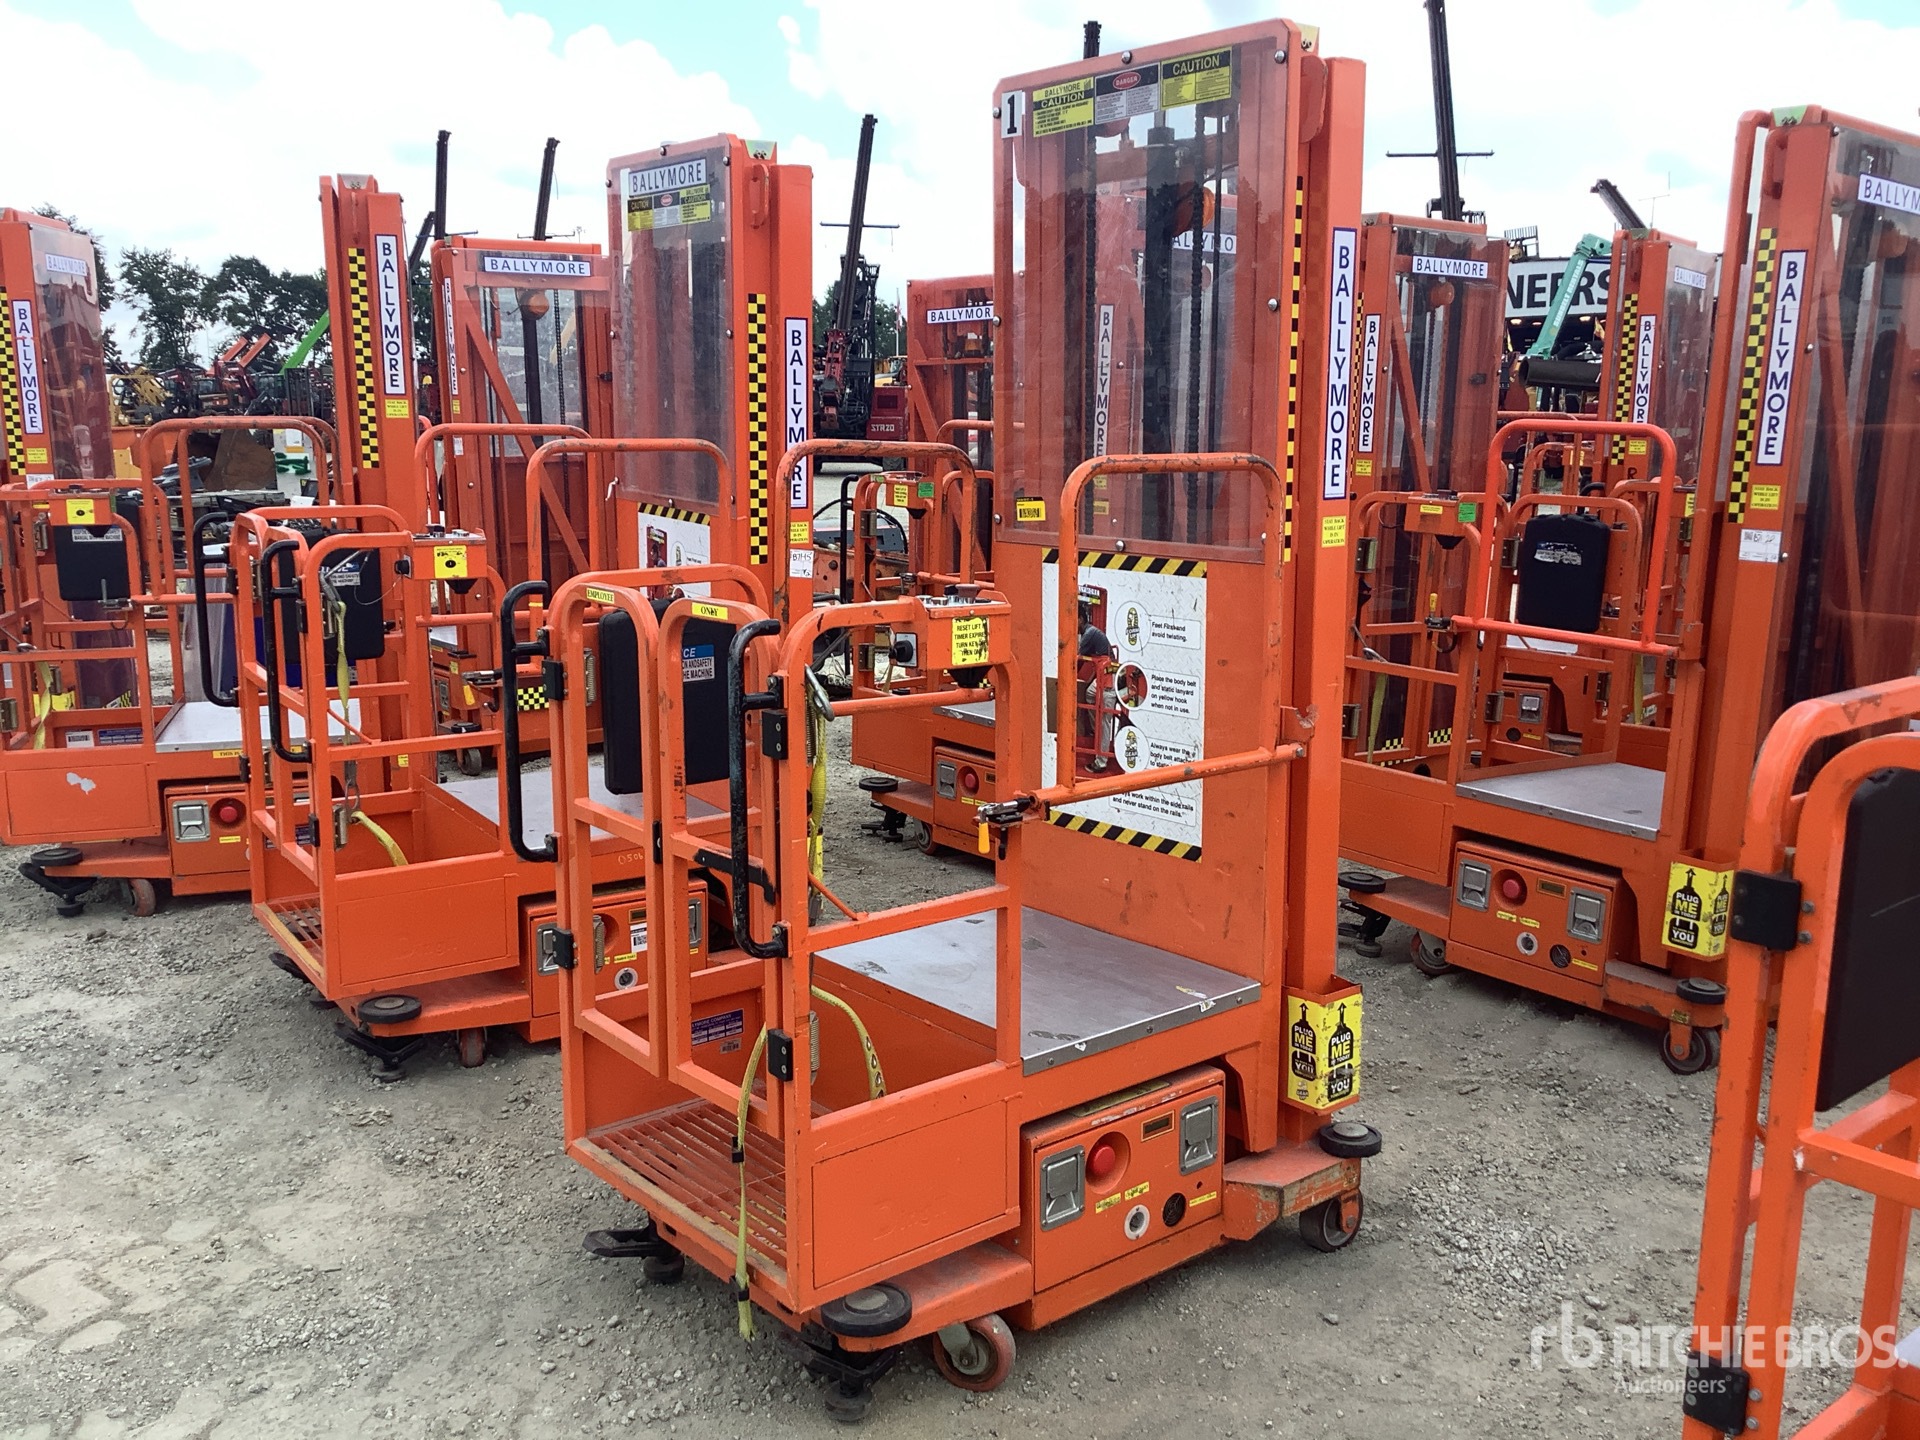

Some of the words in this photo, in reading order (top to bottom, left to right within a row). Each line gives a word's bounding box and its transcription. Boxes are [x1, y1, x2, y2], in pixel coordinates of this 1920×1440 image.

[1172, 54, 1220, 76] CAUTION
[1115, 75, 1138, 86] DANGER
[1044, 82, 1081, 98] BALLYMORE
[1041, 91, 1085, 108] CAUTION
[1007, 94, 1017, 135] 1
[632, 162, 702, 193] BALLYMORE
[48, 256, 85, 274] BALLYMORE
[490, 258, 585, 274] BALLYMORE
[1416, 258, 1484, 276] BALLYMORE
[382, 242, 400, 388] BALLYMORE
[930, 307, 991, 322] BALLYMOR
[1764, 260, 1798, 455] BALLYMORE
[18, 308, 38, 429] BALLYMORE
[1330, 245, 1349, 487] BALLYMORE
[1636, 320, 1651, 423] BALLYMOR
[1362, 321, 1376, 446] BALLYMORE
[788, 329, 805, 500] BALLYMRE
[587, 588, 614, 602] EMPLOYEE
[700, 606, 718, 617] ONLY
[954, 632, 968, 640] TIMER
[956, 640, 968, 648] TURN
[683, 647, 697, 658] CE
[690, 667, 713, 679] MACHINE
[1151, 674, 1164, 682] Place
[1174, 678, 1186, 686] body
[1187, 679, 1196, 687] belt
[1161, 684, 1175, 693] static
[1175, 686, 1194, 696] lanyard
[1158, 694, 1173, 702] yellow
[1175, 695, 1187, 704] hook
[1165, 703, 1173, 711] not
[1150, 742, 1168, 752] Always
[1150, 752, 1162, 761] body
[1123, 799, 1136, 807] never
[1138, 802, 1152, 810] stand
[1160, 807, 1168, 815] the
[1145, 794, 1160, 803] within
[1161, 797, 1169, 806] the
[1170, 800, 1182, 808] side
[1676, 891, 1699, 904] PLUG
[1675, 899, 1698, 915] ME
[1681, 911, 1697, 919] TODAY
[1672, 929, 1695, 943] YOU
[692, 1019, 710, 1028] LYMORE
[711, 1013, 732, 1022] COMPANY
[1294, 1025, 1314, 1038] PLUG
[1331, 1031, 1351, 1046] PLUG
[1294, 1032, 1313, 1048] ME
[1331, 1040, 1351, 1060] ME
[1336, 1054, 1350, 1063] TODAY
[1295, 1061, 1314, 1074] YOU
[1331, 1078, 1350, 1094] YOU
